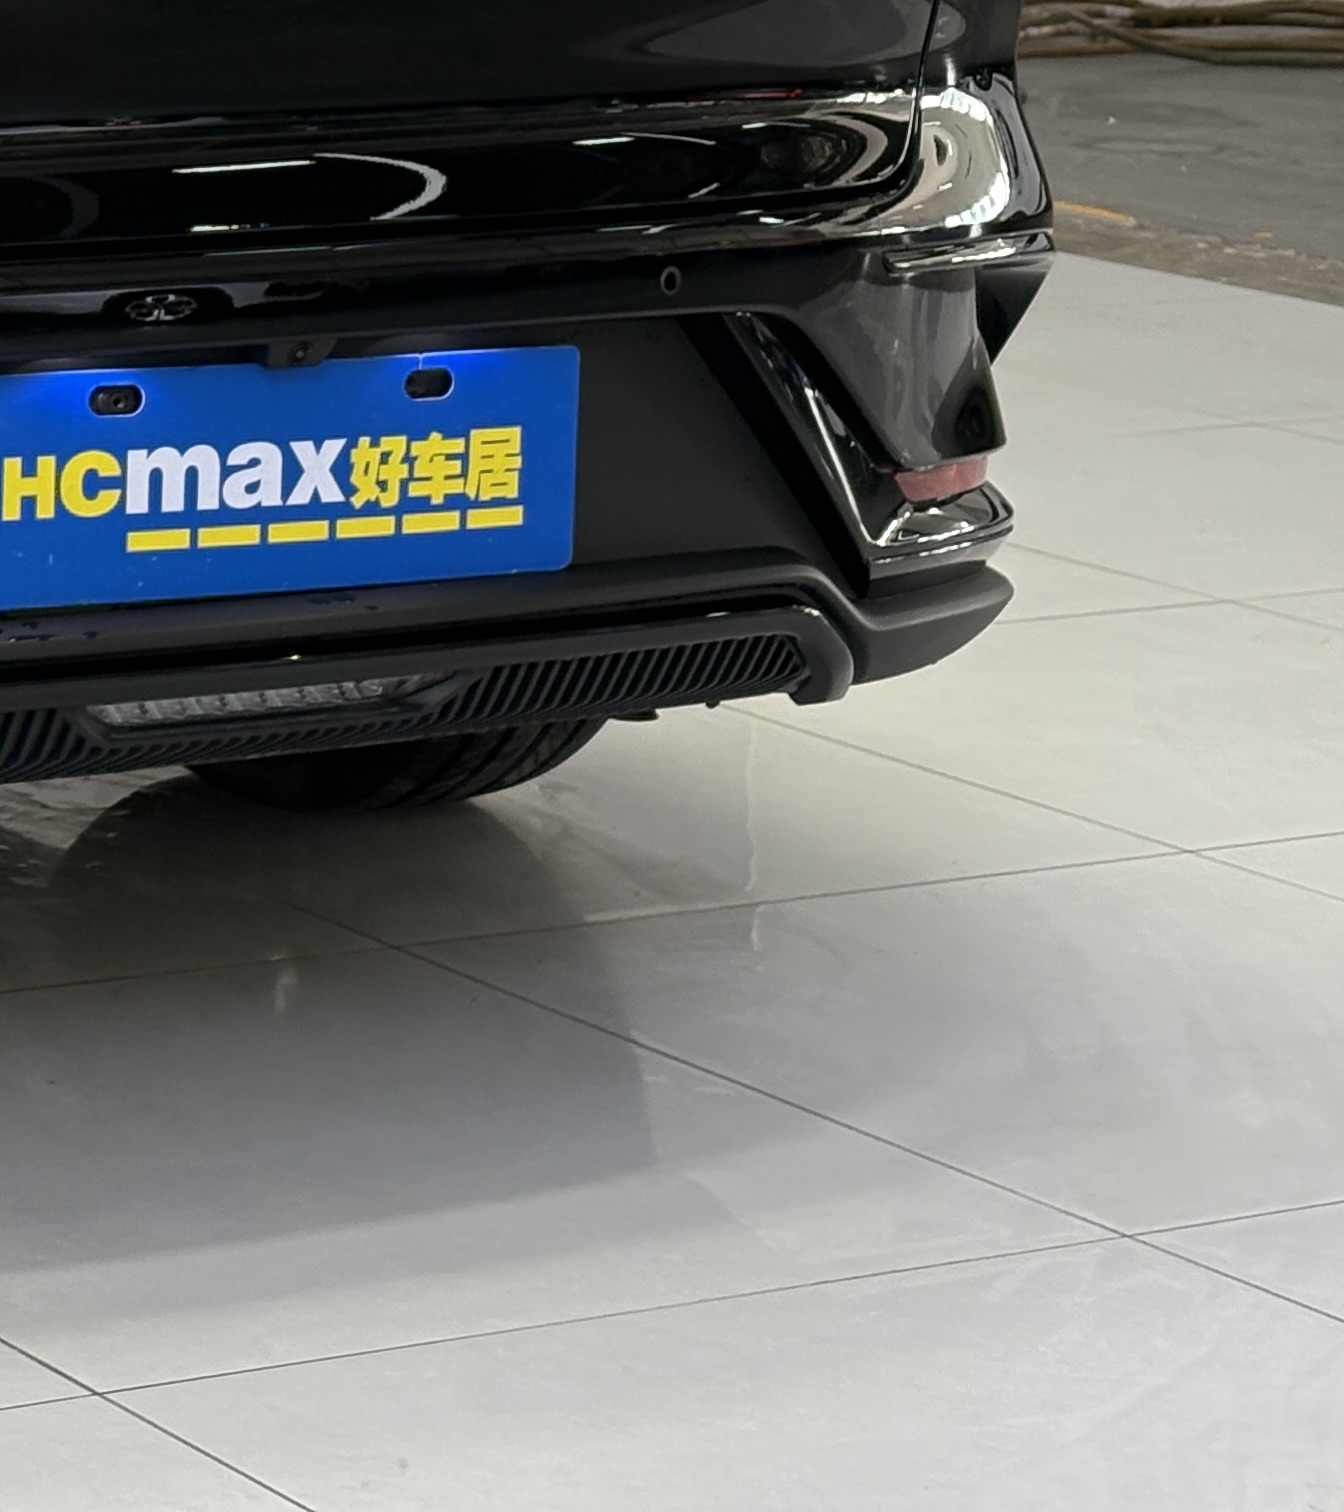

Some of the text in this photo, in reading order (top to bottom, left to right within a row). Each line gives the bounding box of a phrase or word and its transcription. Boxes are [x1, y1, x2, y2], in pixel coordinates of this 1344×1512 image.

[0, 423, 524, 522] HCmax 好车居
